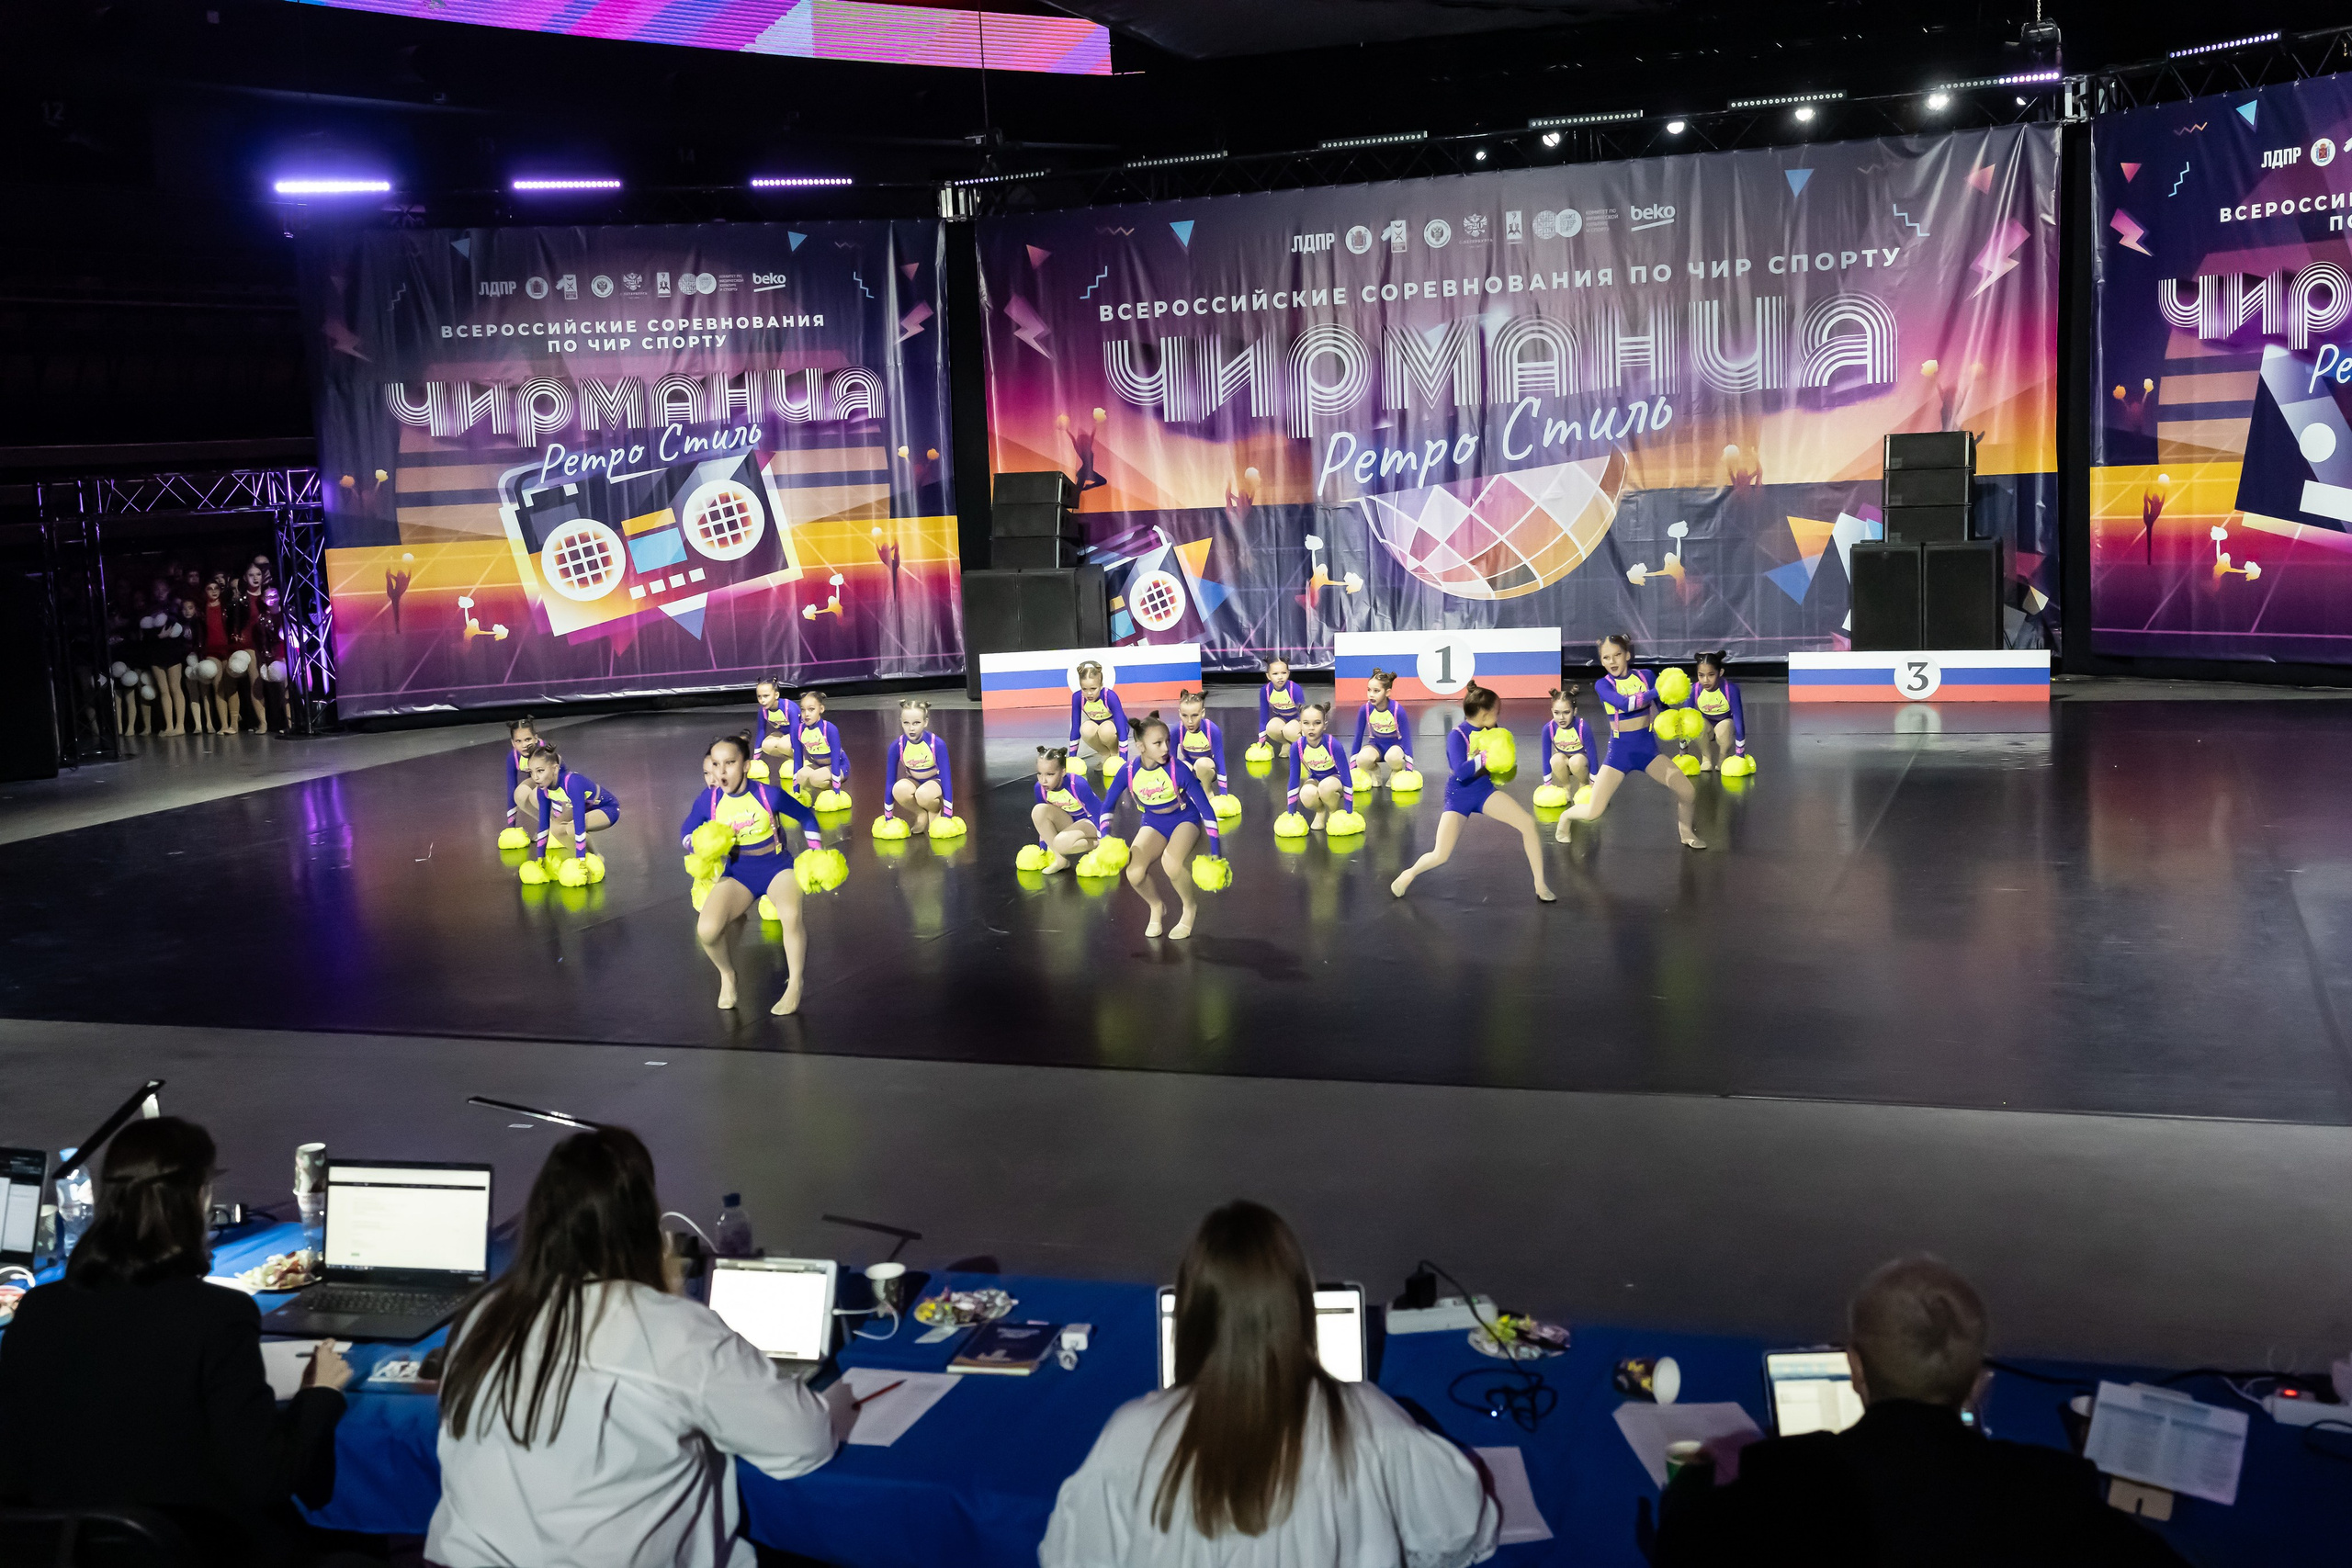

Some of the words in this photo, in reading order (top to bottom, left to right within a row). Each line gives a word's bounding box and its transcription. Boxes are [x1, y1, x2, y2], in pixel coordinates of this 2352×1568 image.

[2261, 146, 2302, 169] ЛДПР
[1630, 203, 1676, 221] beko
[2220, 191, 2352, 223] ВСЕРОССИ
[1291, 232, 1335, 254] ЛДПР
[478, 280, 517, 298] ЛДПР
[752, 272, 786, 286] beko
[1099, 287, 1347, 322] ВСЕРОССИЙСКИЕ
[1362, 267, 1614, 304] СОРЕВНОВАНИЯ
[1630, 264, 1672, 285] ПО
[1688, 258, 1752, 280] ЧИР
[1769, 247, 1902, 275] СПОРТУ
[440, 318, 639, 339] ВСЕРОССИЙСКИЕ
[647, 314, 826, 333] СОРЕВНОВАНИЯ
[547, 338, 579, 354] ПО
[587, 336, 634, 352] ЧИР
[641, 334, 728, 352] СПОРТУ
[539, 445, 644, 485] Ретро
[659, 423, 763, 463] Стиль
[1317, 431, 1479, 498] Ретро
[1502, 396, 1673, 462] Стиль
[1434, 645, 1456, 683] 1
[1906, 661, 1929, 692] 3
